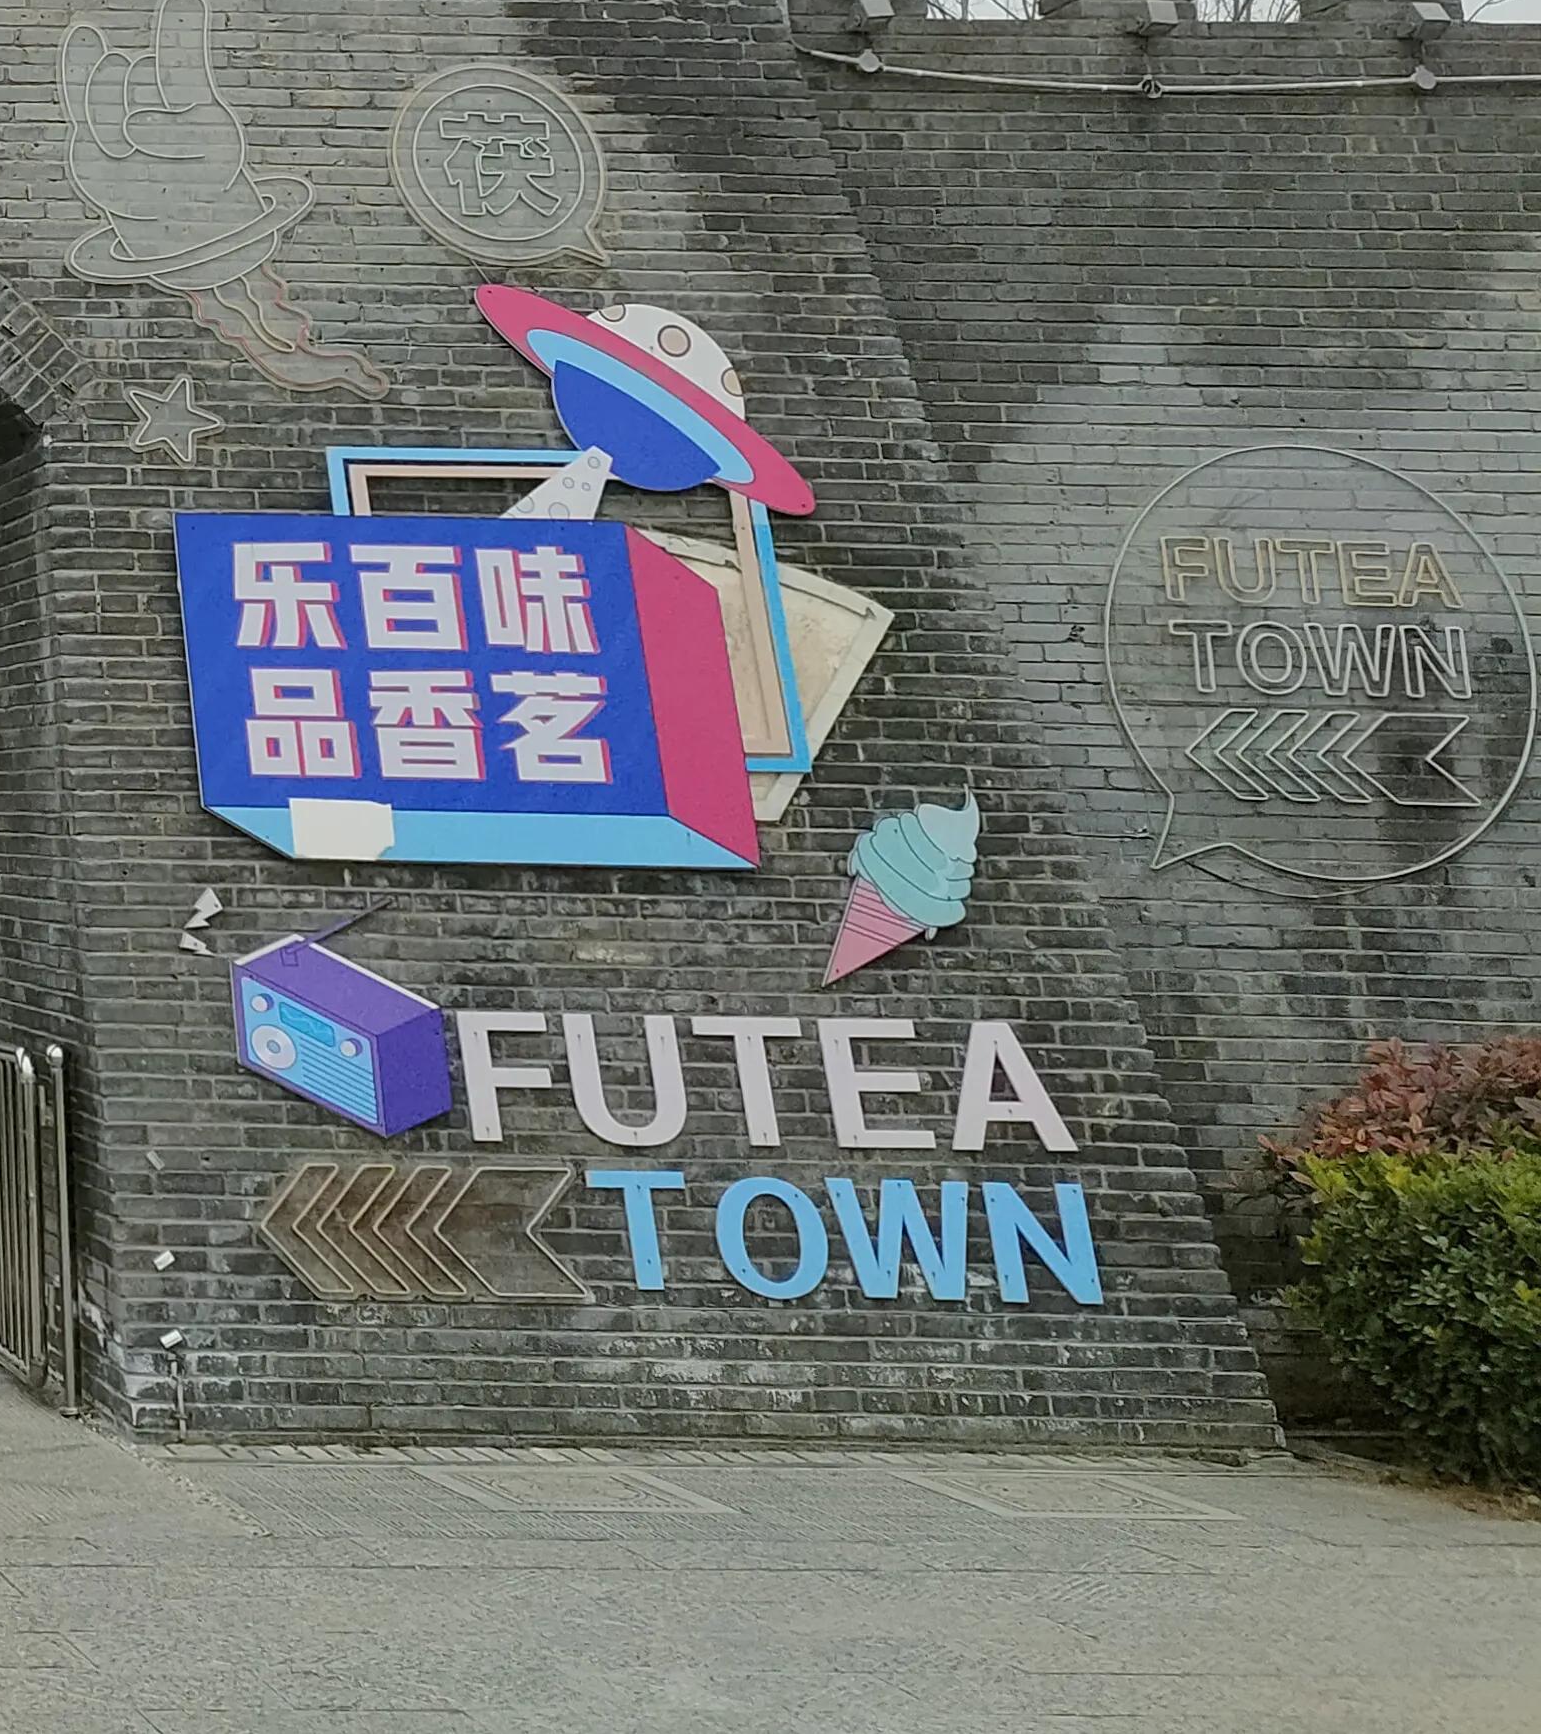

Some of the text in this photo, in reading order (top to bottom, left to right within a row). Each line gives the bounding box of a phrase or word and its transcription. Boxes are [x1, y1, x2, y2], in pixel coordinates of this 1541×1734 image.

[439, 112, 562, 216] 茯
[232, 542, 601, 654] 乐百味
[1160, 536, 1464, 608] FUTEA
[1168, 619, 1473, 700] TOWN
[245, 667, 613, 784] 品香茗
[457, 1011, 1079, 1152] FUTEA
[586, 1168, 1104, 1306] TOWN
